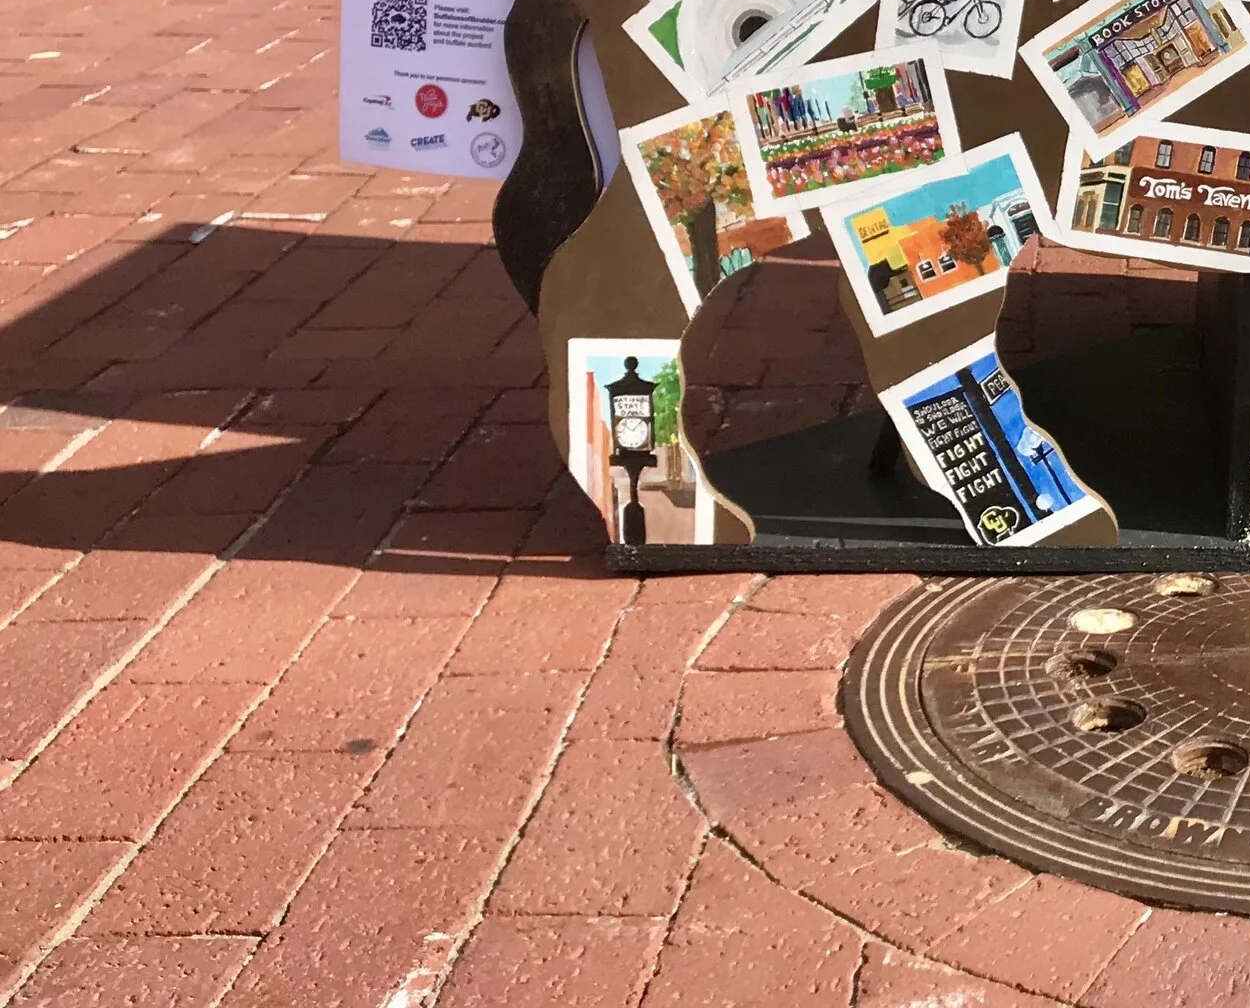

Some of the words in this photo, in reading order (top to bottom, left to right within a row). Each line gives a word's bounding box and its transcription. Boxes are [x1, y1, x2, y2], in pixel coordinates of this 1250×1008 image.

[434, 4, 455, 12] Please
[434, 12, 505, 25] BuffaloesofBoulder.co
[451, 30, 462, 38] the
[463, 32, 484, 41] project
[460, 24, 494, 33] information
[1092, 18, 1132, 46] BOOK
[446, 39, 466, 48] buffalo
[411, 134, 446, 147] CREATE
[1139, 176, 1193, 200] Tom's
[920, 419, 947, 437] WE
[947, 408, 973, 424] WILL
[928, 431, 954, 450] FIGHT
[954, 420, 979, 439] FIGHT
[936, 431, 985, 469] FIGHT
[945, 451, 988, 486] FIGHT
[955, 468, 1003, 504] FIGHT
